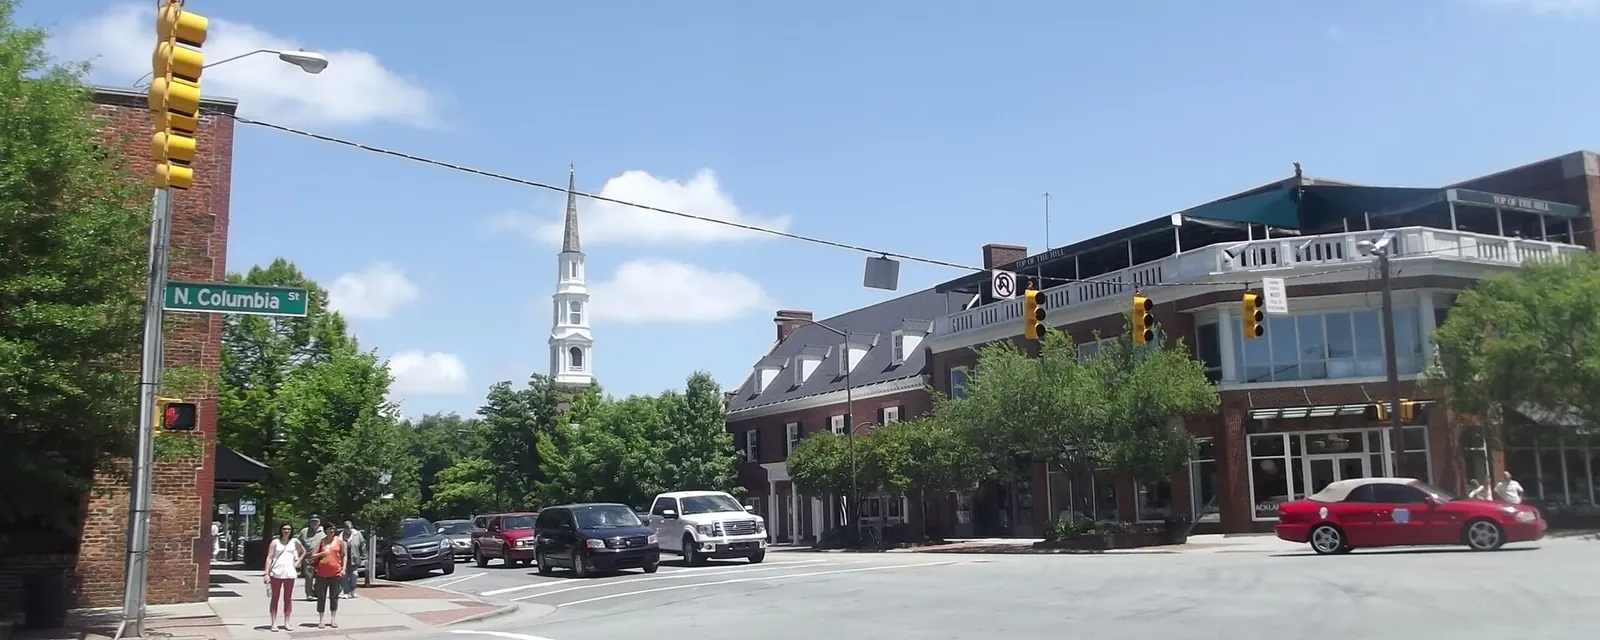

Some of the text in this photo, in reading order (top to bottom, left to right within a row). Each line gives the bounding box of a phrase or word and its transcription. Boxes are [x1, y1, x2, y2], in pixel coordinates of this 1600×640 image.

[174, 286, 300, 309] N. Columbia St
